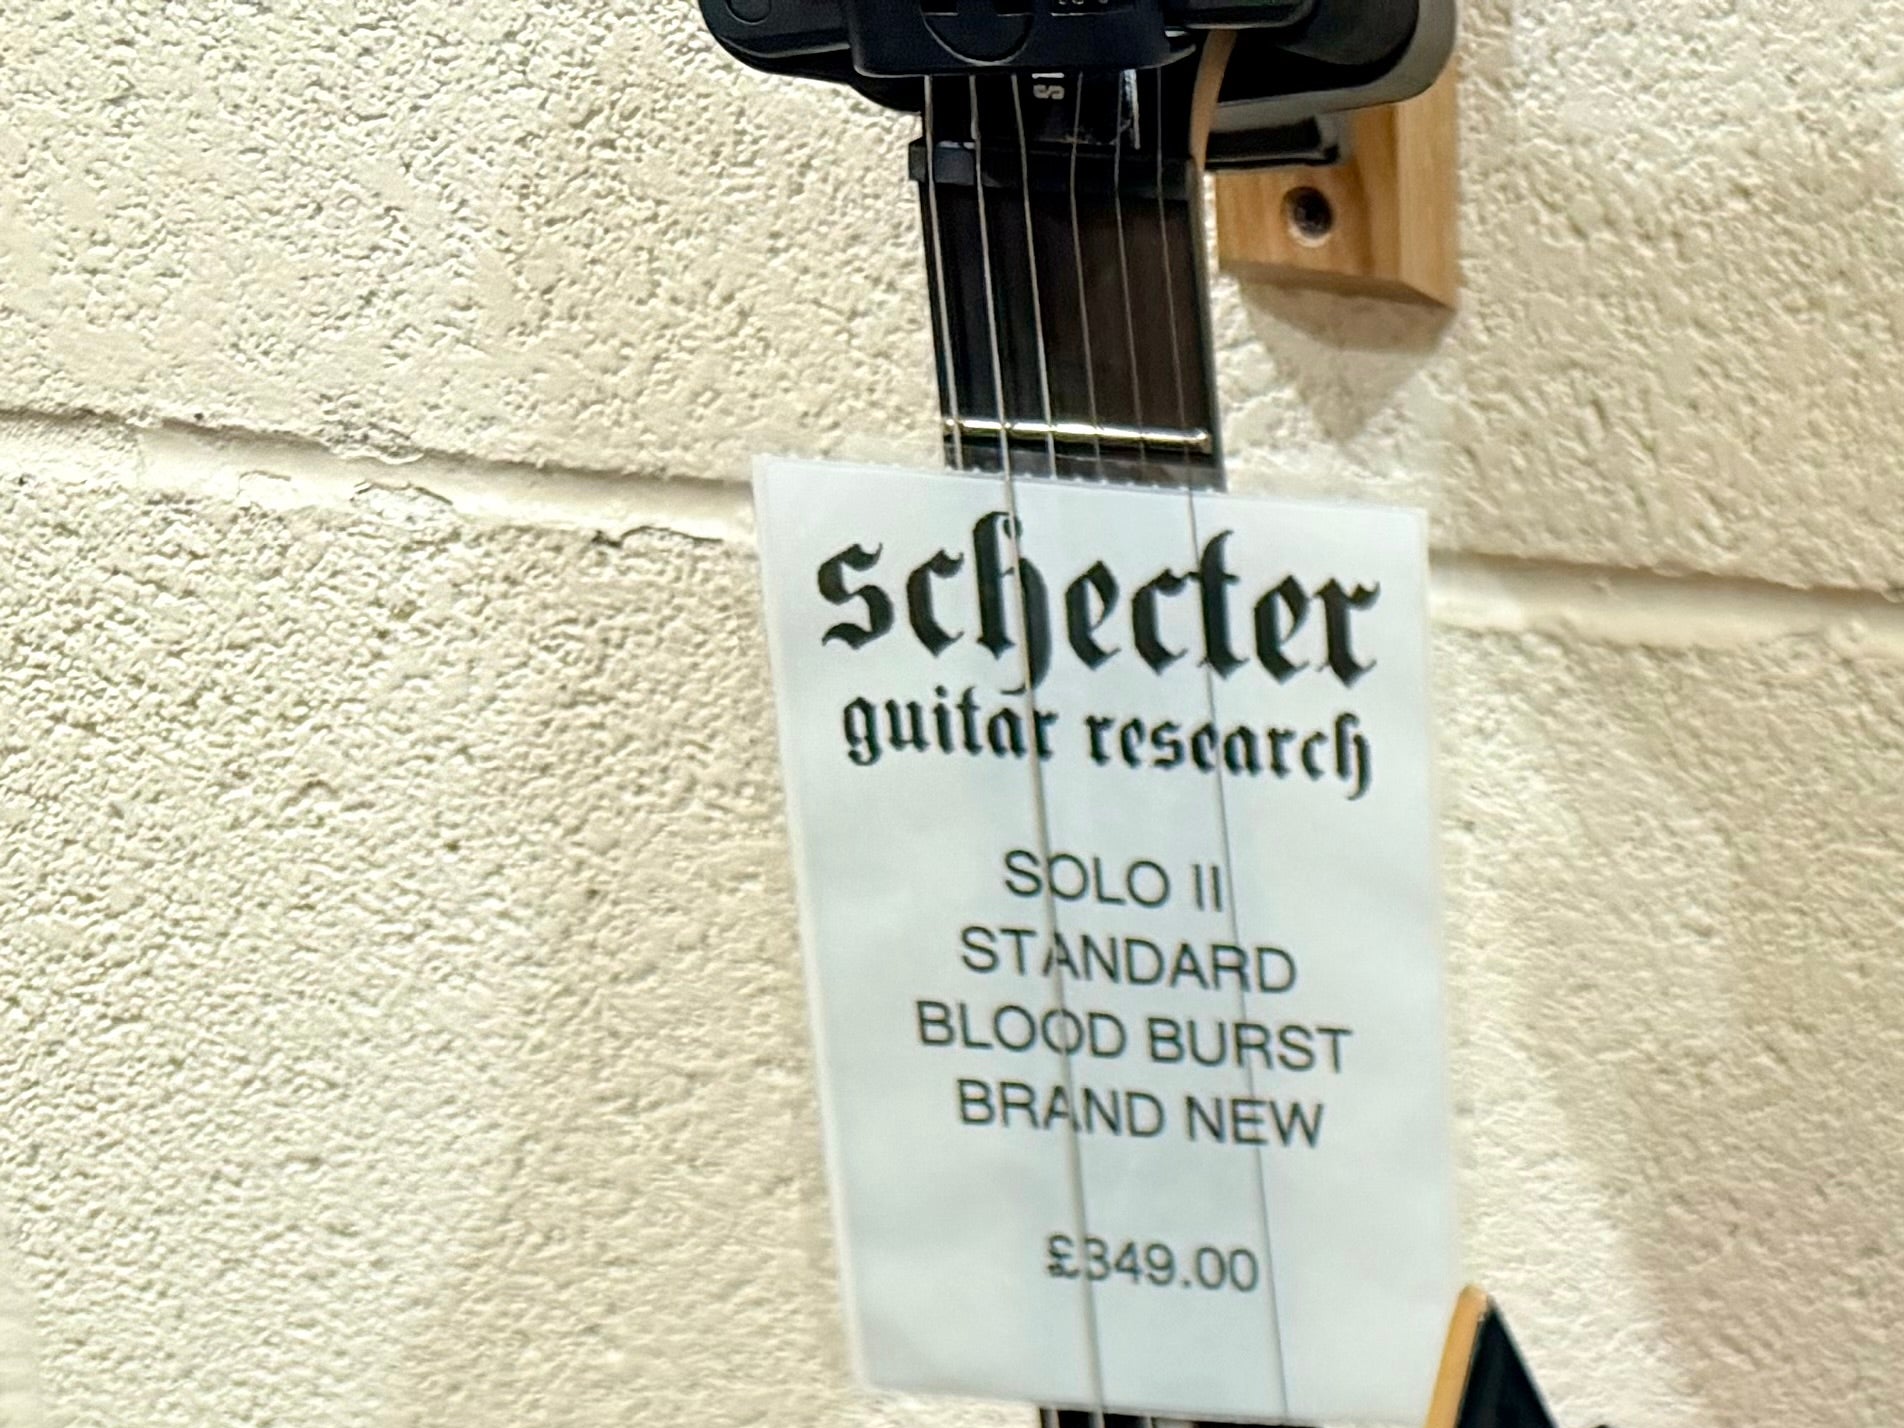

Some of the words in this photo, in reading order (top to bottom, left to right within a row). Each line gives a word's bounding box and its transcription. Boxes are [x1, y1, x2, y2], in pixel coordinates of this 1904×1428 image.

[818, 510, 1381, 694] schecter
[843, 686, 1060, 766] guitar
[1086, 711, 1371, 799] research
[1004, 850, 1170, 909] SOLO
[1195, 864, 1220, 912] II
[962, 926, 1296, 993] STANDARD
[920, 1001, 1126, 1059] BLOOD
[1150, 1022, 1352, 1074] BURST
[958, 1079, 1163, 1139] BRAND
[1186, 1096, 1324, 1149] NEW
[1047, 1235, 1258, 1292] £349.00
